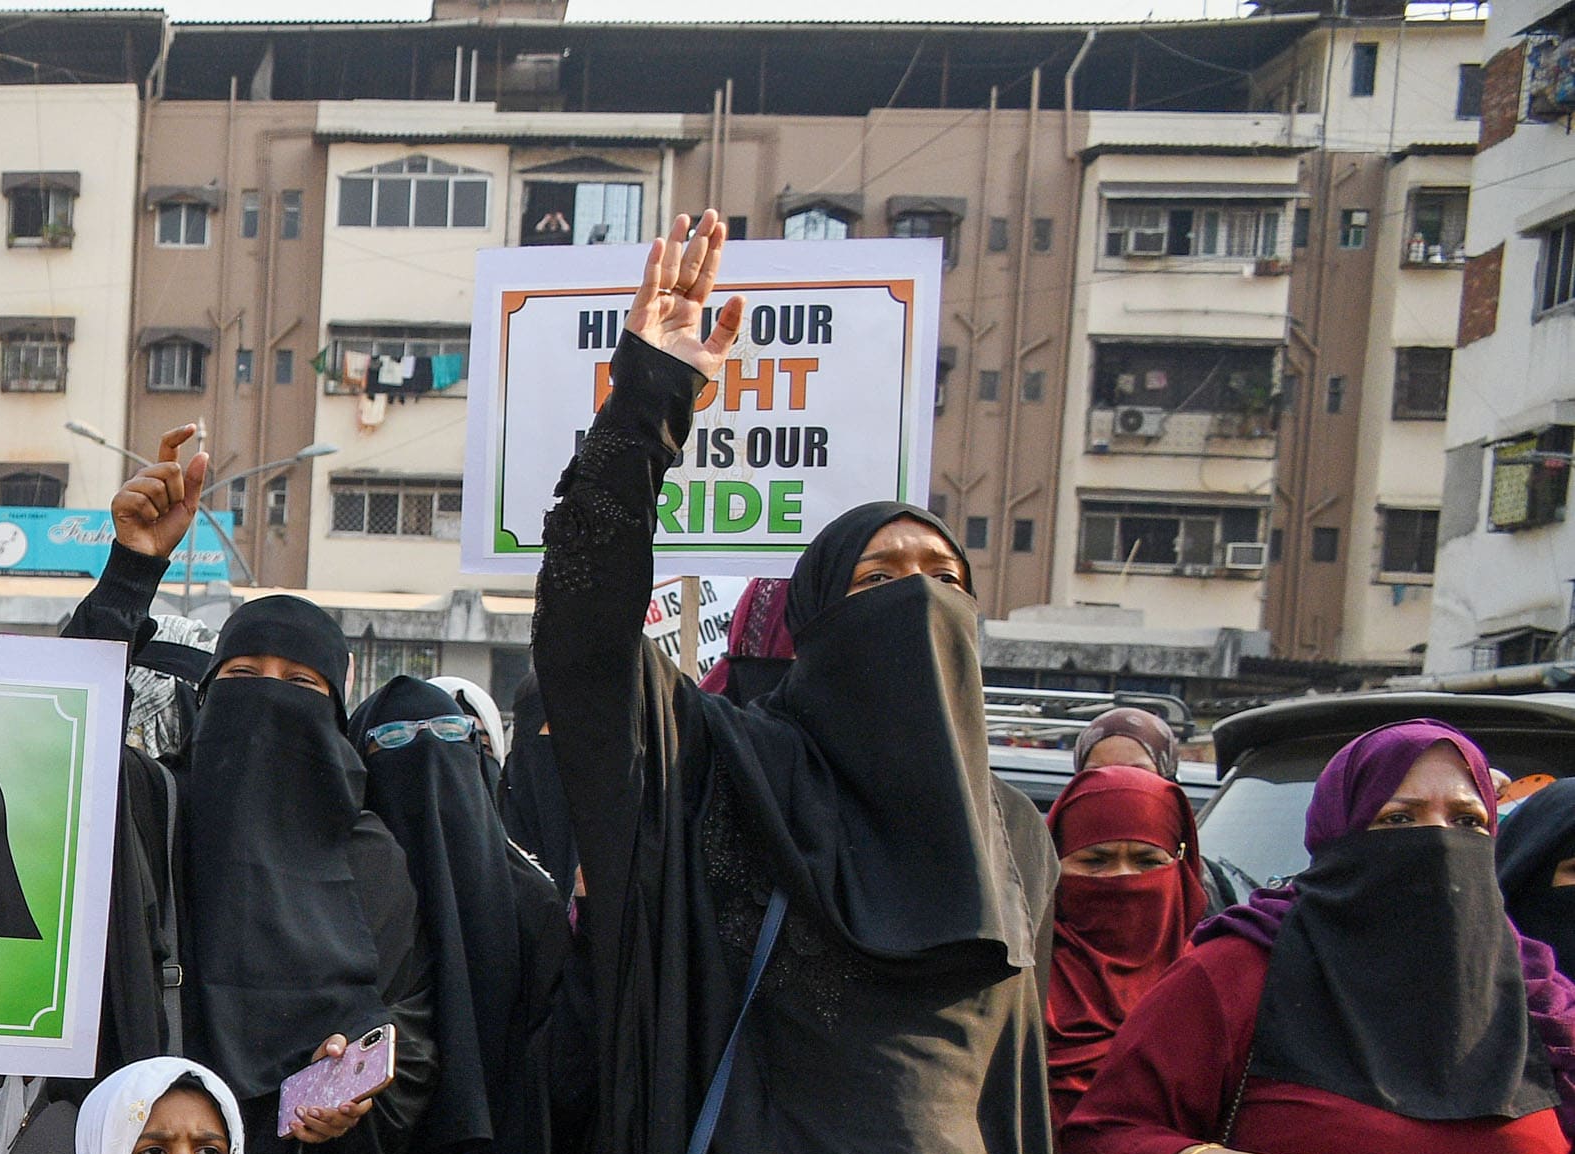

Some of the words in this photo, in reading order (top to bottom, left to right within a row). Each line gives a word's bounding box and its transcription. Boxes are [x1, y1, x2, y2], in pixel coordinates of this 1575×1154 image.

[751, 304, 833, 345] OUR
[696, 428, 735, 468] IS
[747, 426, 828, 468] OUR
[656, 480, 804, 534] RIDE
[662, 591, 681, 618] IS
